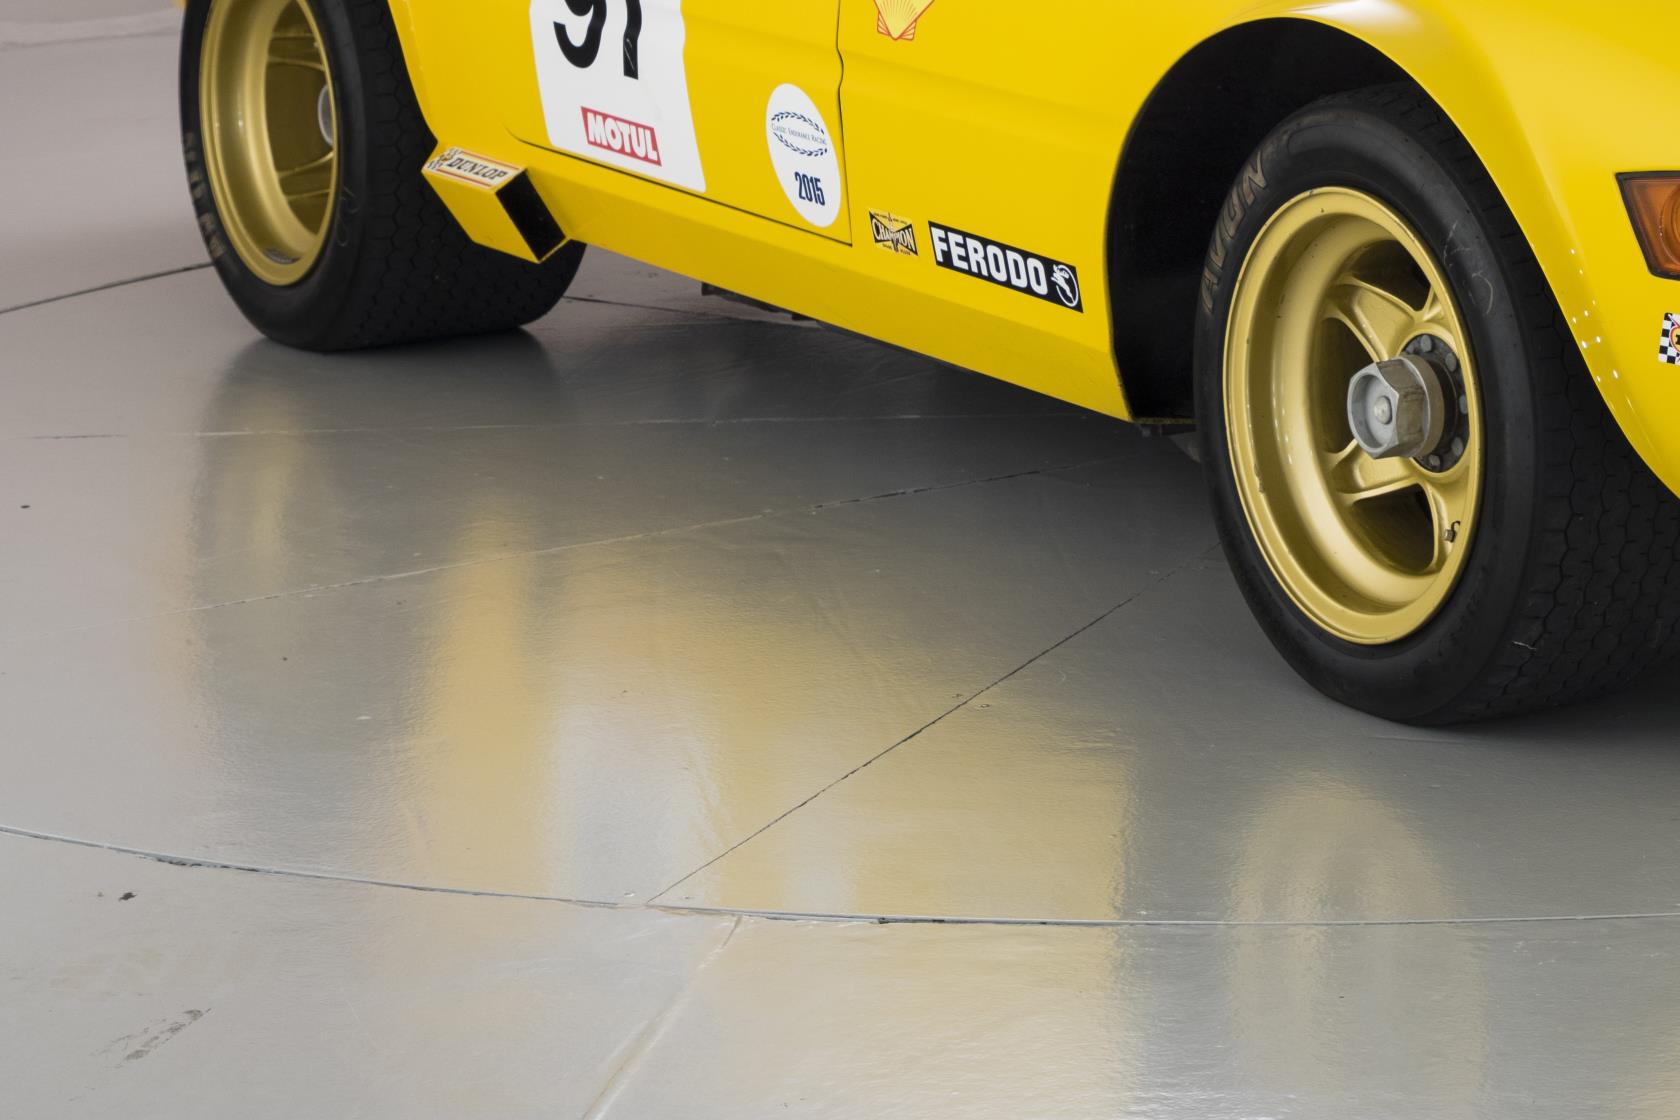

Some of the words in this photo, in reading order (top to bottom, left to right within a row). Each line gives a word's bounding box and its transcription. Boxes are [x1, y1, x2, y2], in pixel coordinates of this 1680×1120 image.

[586, 111, 659, 164] MOTUL
[447, 157, 509, 181] DUNLOP
[794, 171, 826, 207] 2015
[930, 226, 1049, 296] FERODO
